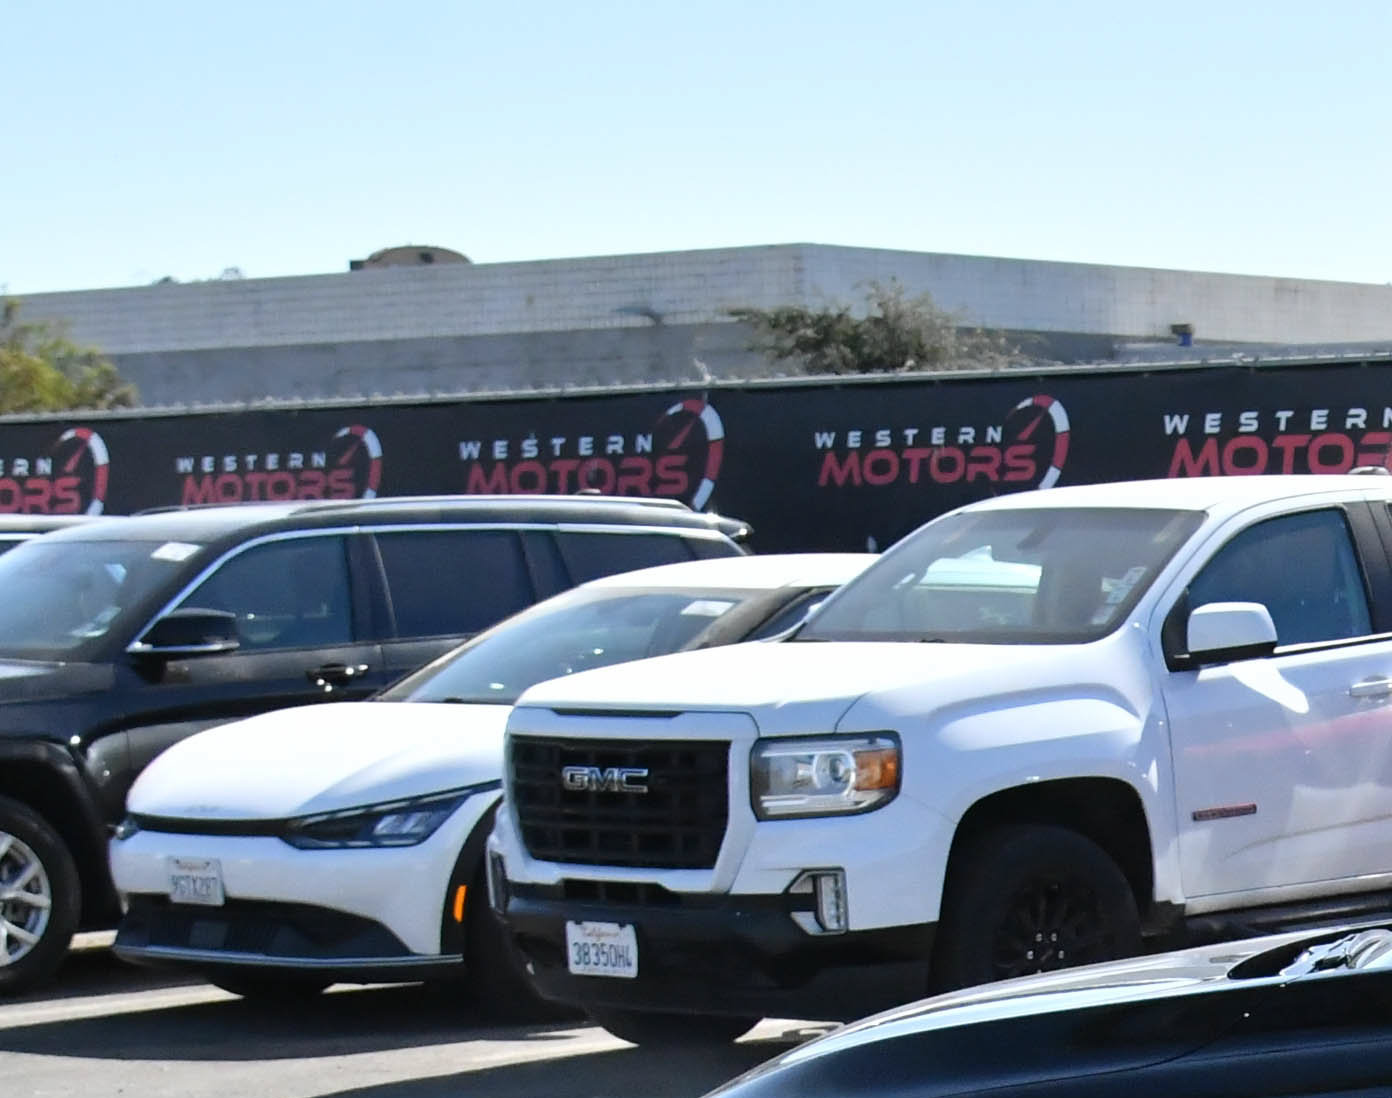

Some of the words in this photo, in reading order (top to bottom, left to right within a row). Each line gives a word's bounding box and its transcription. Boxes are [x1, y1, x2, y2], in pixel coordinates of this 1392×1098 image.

[459, 434, 653, 460] WESTERN
[814, 426, 1002, 449] WESTERN
[176, 452, 327, 473] WESTERN
[466, 455, 689, 495] MOTORS
[817, 444, 1037, 487] MOTORS
[181, 469, 355, 506] MOTORS
[562, 766, 648, 793] GMC
